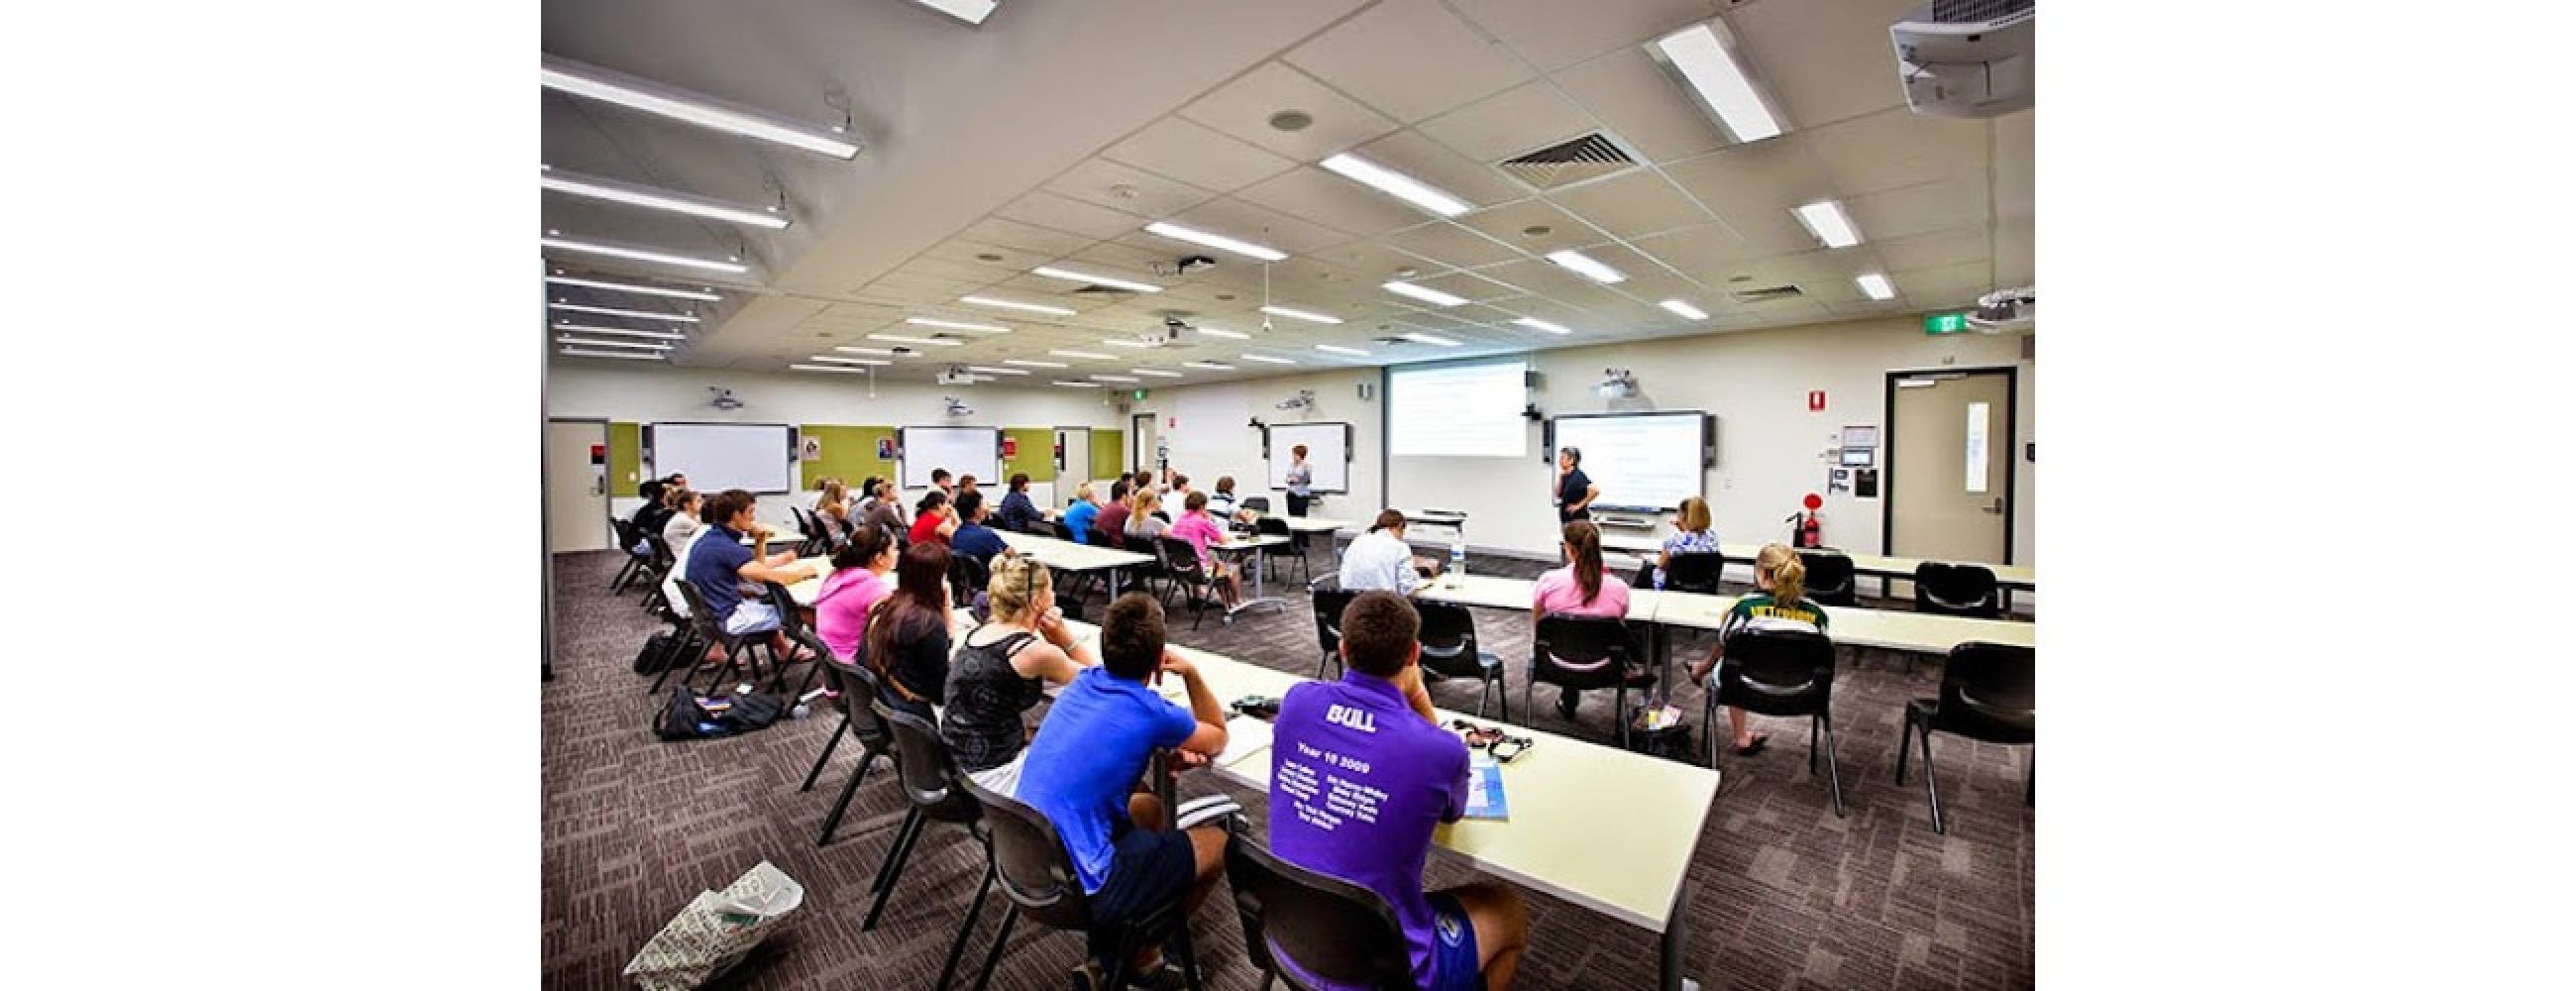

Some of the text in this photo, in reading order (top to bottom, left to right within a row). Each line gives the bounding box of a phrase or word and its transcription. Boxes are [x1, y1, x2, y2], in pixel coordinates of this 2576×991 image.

[1326, 704, 1376, 733] BULL
[1298, 742, 1322, 757] Year
[1325, 752, 1338, 765] 10
